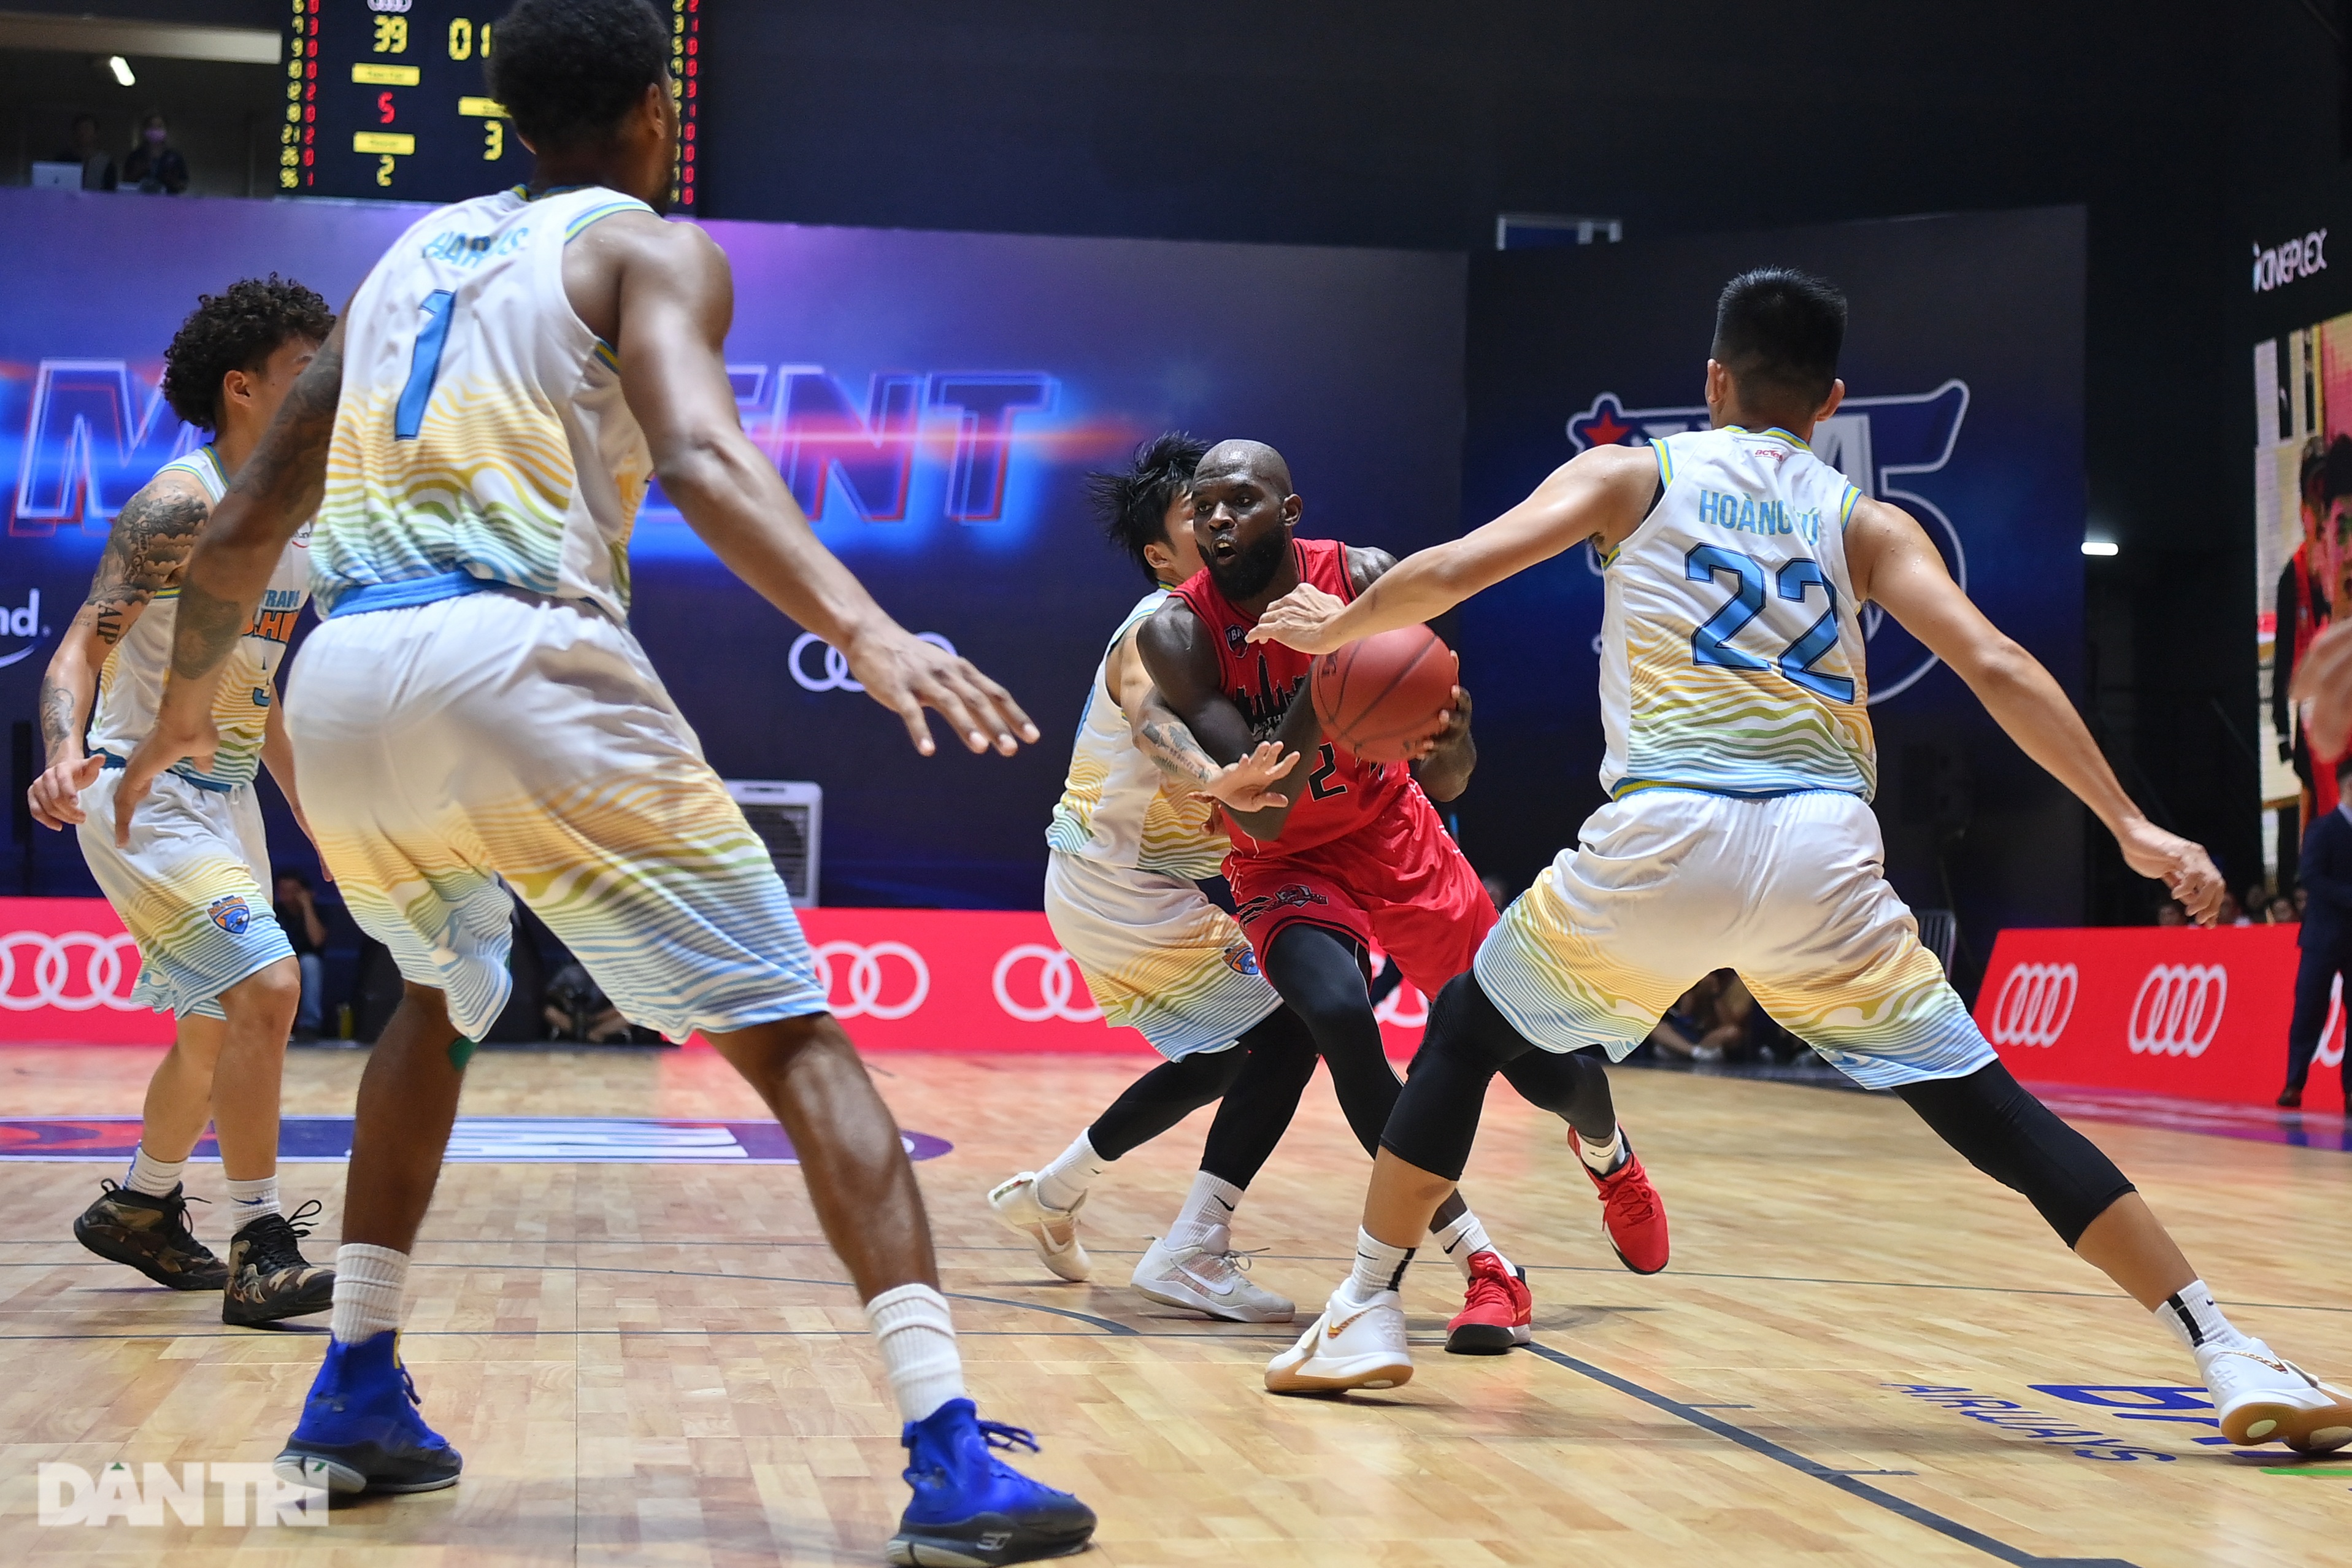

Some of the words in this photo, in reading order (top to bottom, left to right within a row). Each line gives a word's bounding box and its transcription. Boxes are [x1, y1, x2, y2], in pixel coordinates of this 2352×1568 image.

[373, 15, 408, 53] 39
[378, 91, 396, 123] 5
[483, 120, 503, 161] 3
[377, 155, 395, 186] 2
[394, 288, 456, 442] 1
[1685, 542, 1854, 705] 22
[1880, 1383, 2177, 1462] AIRWAYS
